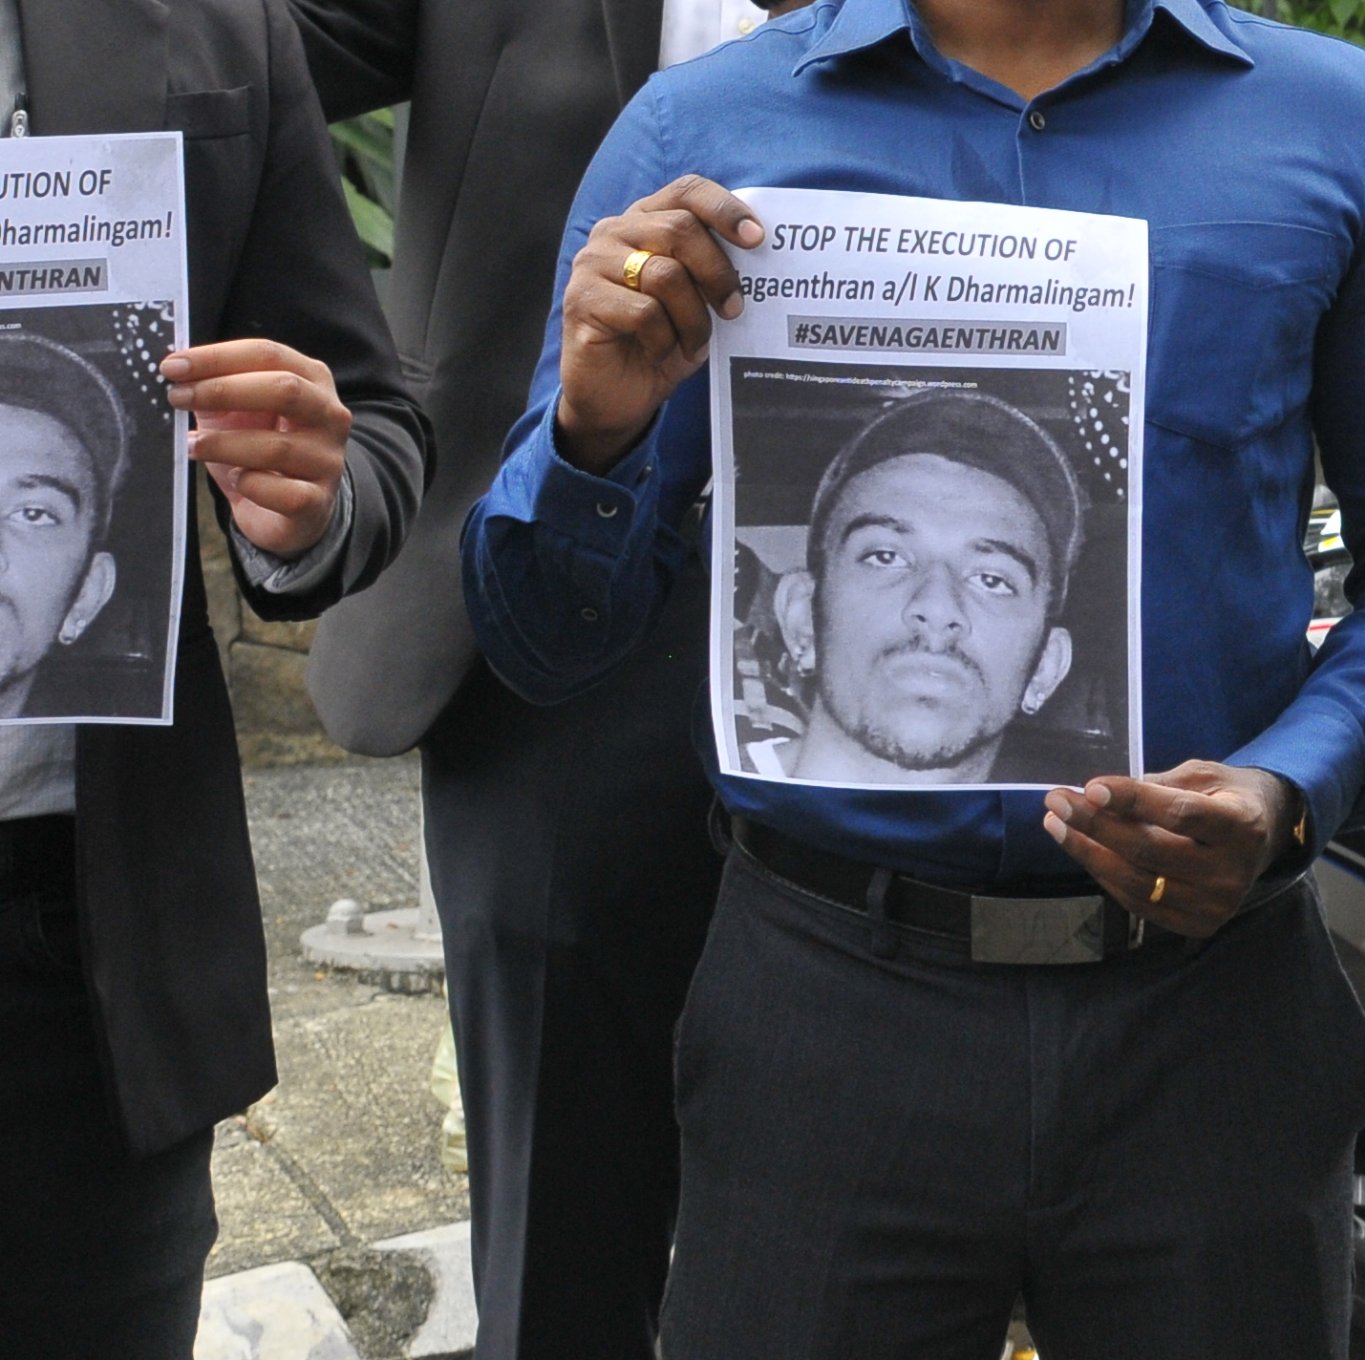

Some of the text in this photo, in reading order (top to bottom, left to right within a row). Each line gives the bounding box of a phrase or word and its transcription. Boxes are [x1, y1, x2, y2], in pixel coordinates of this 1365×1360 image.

[79, 170, 112, 196] OF
[0, 211, 172, 247] harmalingam!
[771, 224, 1077, 262] STOP THE EXECUTION OF
[740, 270, 875, 303] agaenthran
[924, 275, 942, 301] K
[946, 275, 1136, 311] Dharmalingam!
[794, 322, 1060, 351] #SAVENAGAENTHRAN
